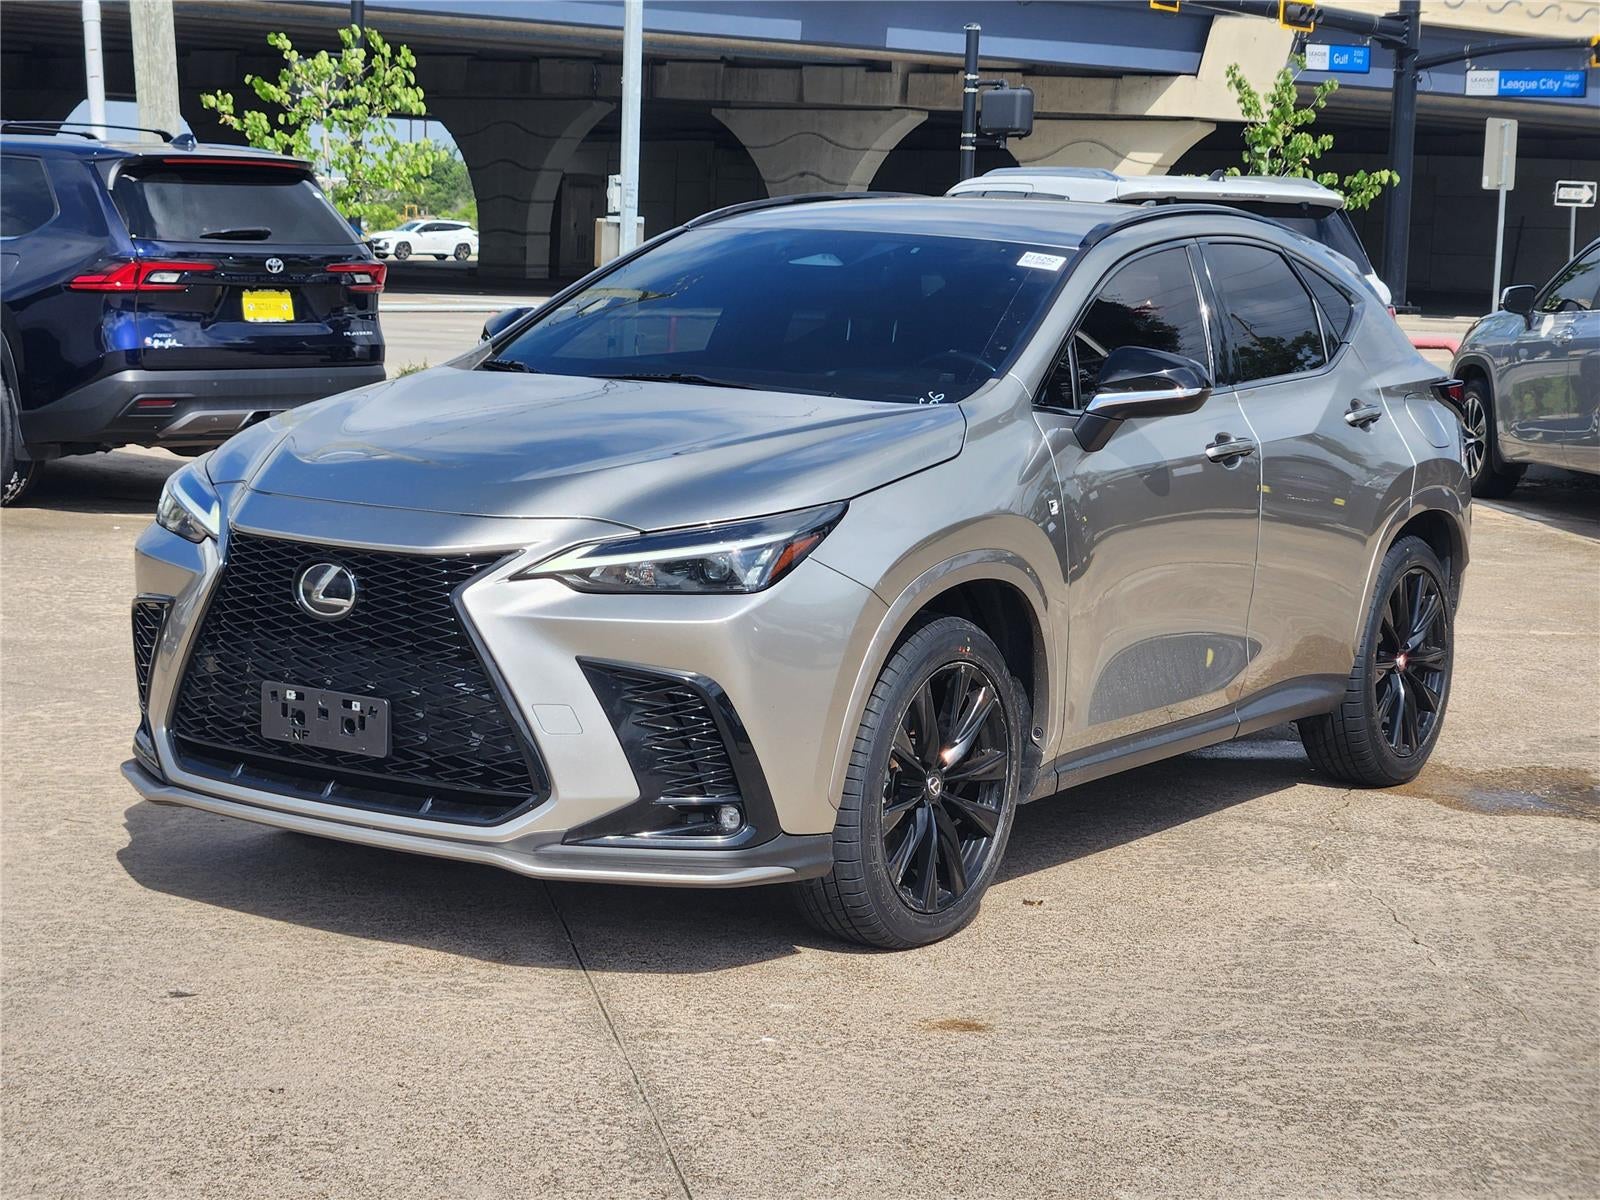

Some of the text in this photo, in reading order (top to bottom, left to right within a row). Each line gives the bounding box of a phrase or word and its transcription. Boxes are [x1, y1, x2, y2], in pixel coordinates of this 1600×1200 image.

[1333, 53, 1349, 64] Gulf
[1501, 78, 1537, 92] League
[1540, 78, 1560, 92] City
[292, 728, 310, 741] NF
